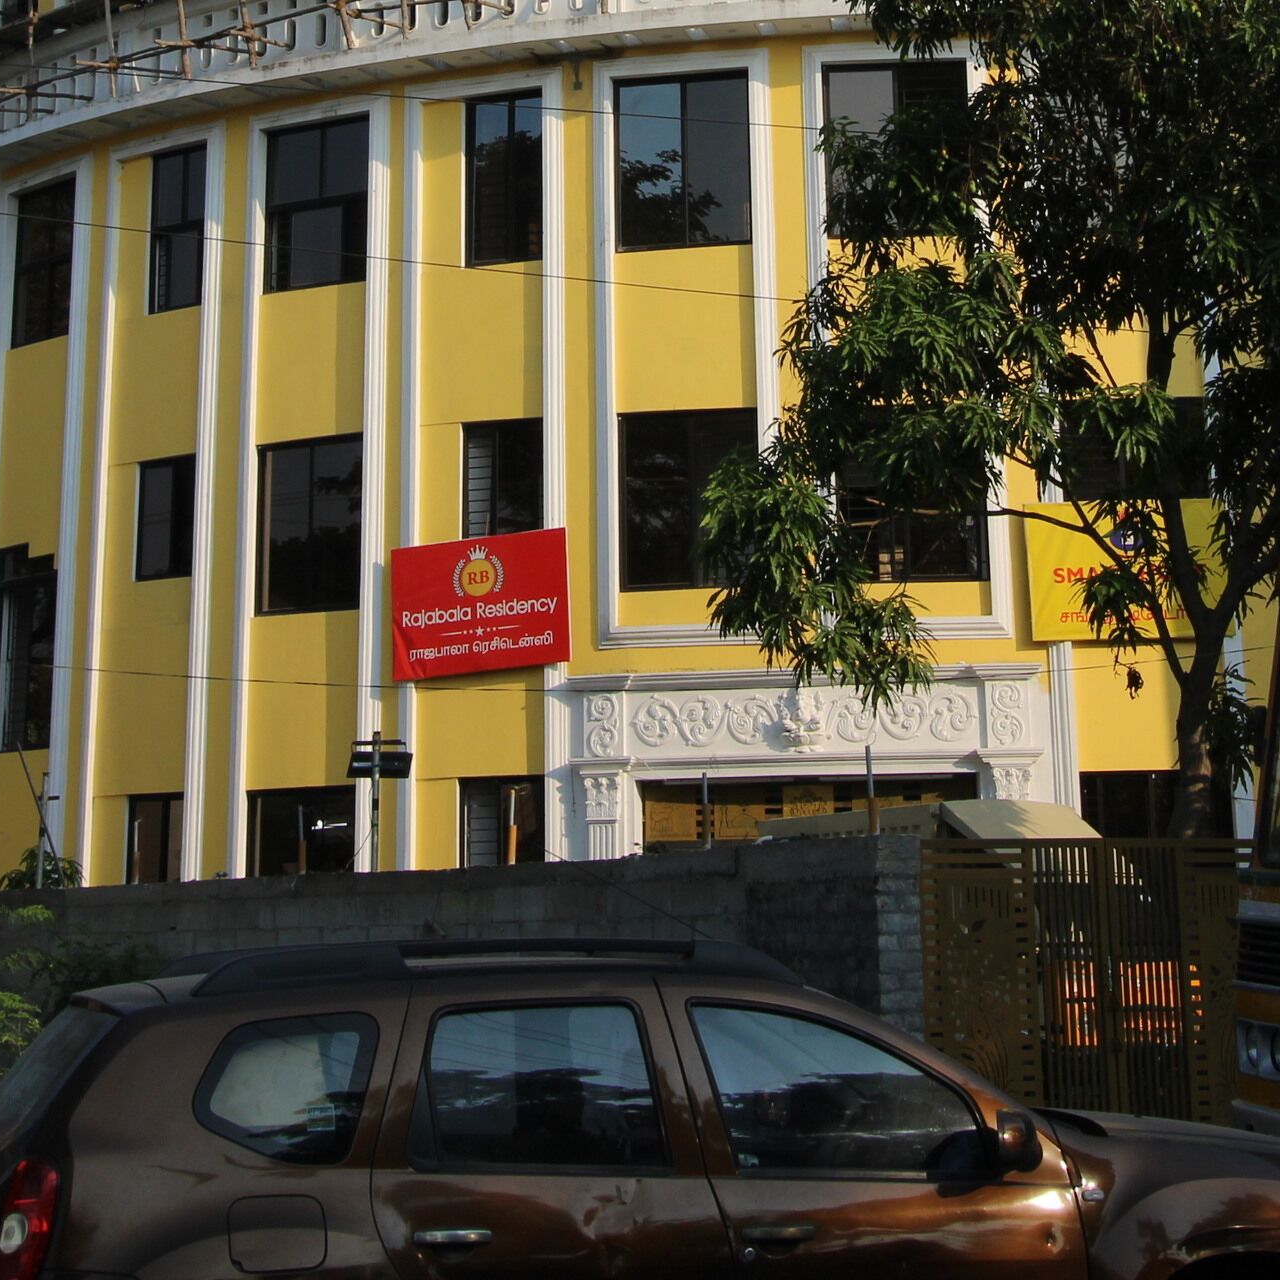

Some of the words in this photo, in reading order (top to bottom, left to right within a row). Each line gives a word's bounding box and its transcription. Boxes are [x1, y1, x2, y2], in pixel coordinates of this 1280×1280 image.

[466, 570, 490, 586] RB
[402, 605, 472, 629] Rajabala
[476, 596, 558, 619] Residency
[409, 643, 469, 662] ராஜபாலா
[472, 631, 554, 655] ரெசிடென்ஸி
